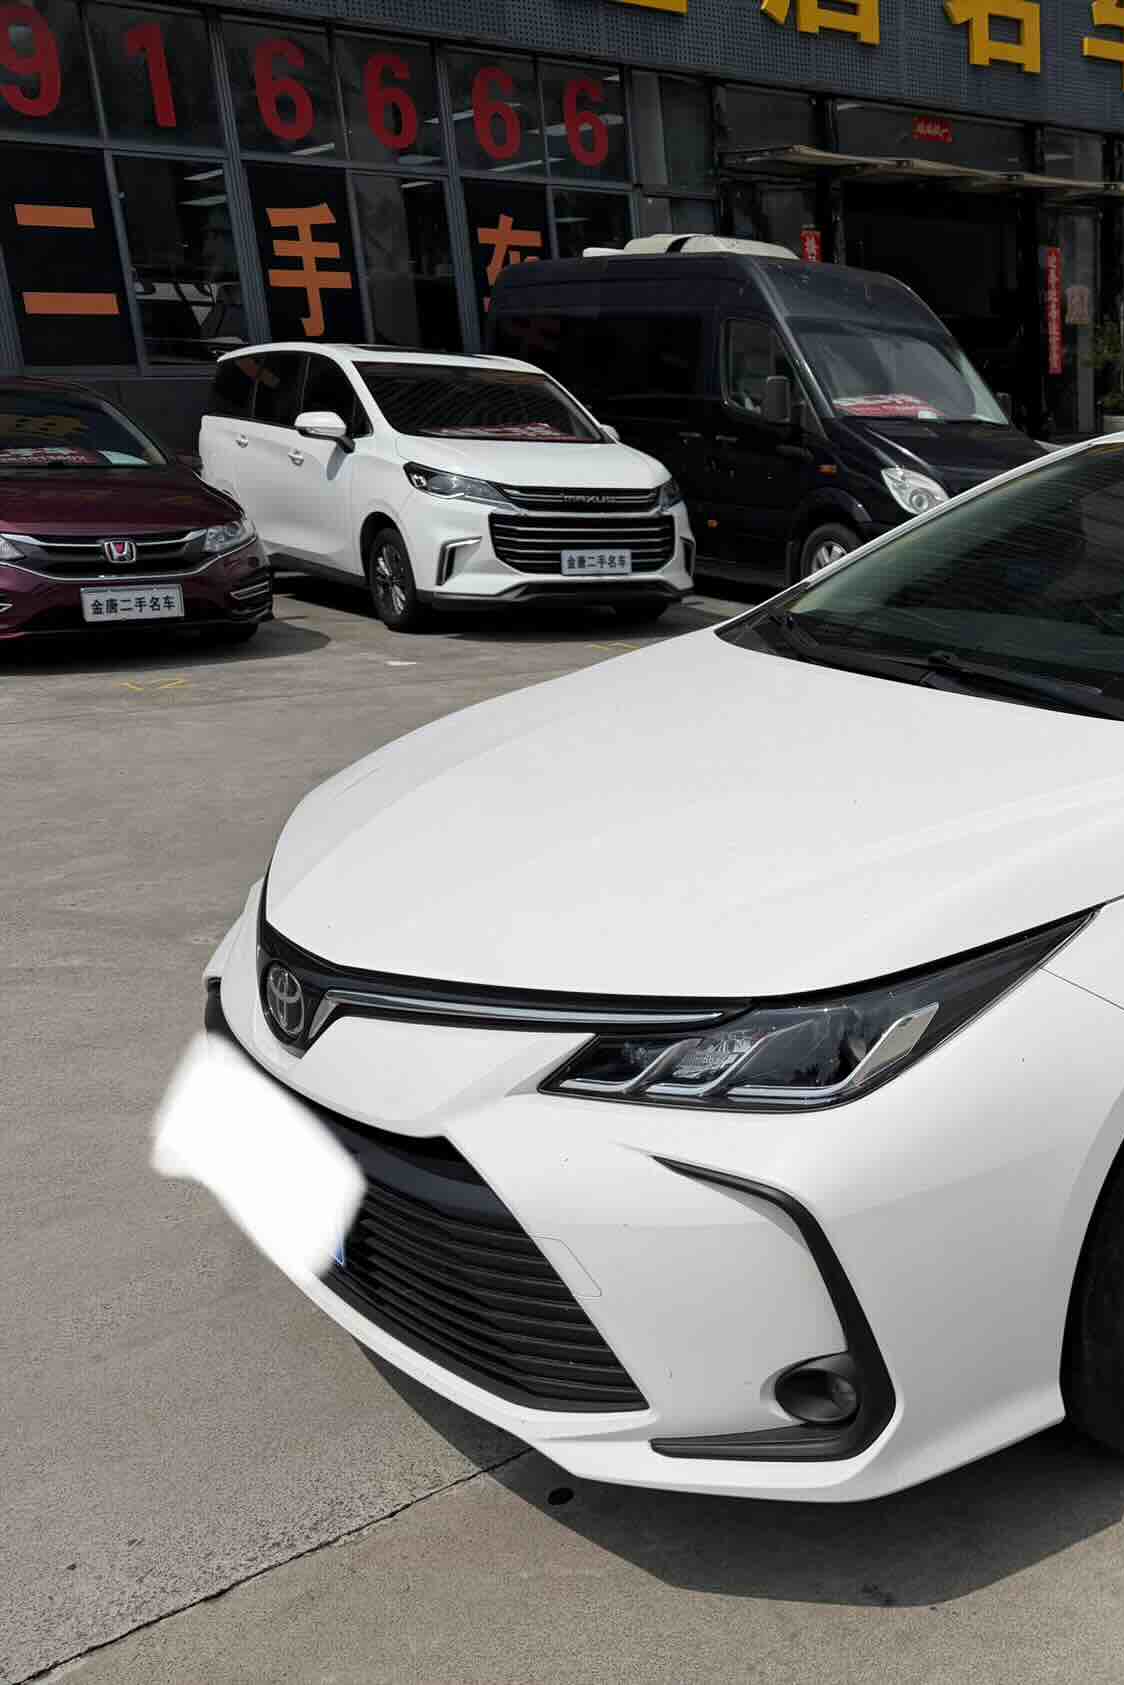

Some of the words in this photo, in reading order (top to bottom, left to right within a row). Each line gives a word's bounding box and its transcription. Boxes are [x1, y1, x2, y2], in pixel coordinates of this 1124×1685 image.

[90, 595, 176, 616] 金唐二手名车
